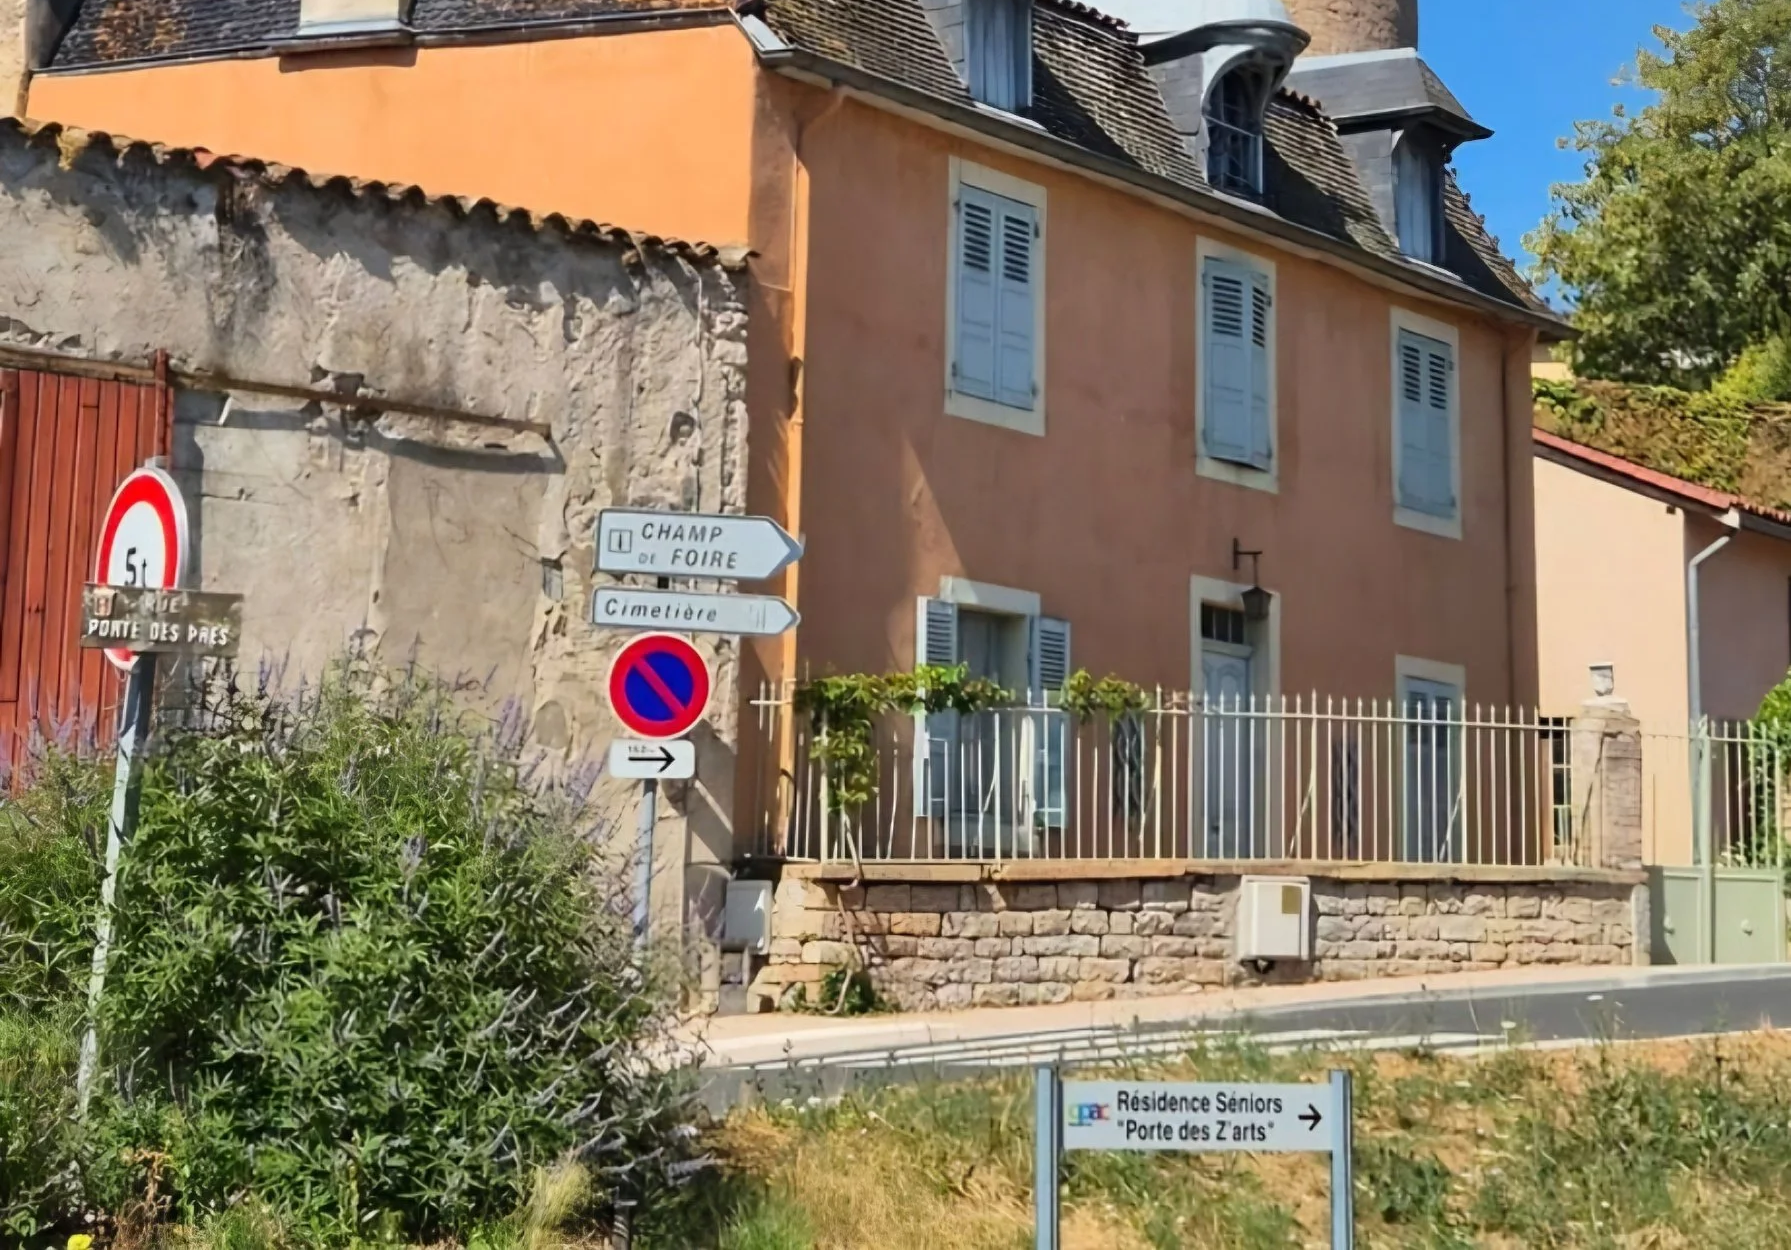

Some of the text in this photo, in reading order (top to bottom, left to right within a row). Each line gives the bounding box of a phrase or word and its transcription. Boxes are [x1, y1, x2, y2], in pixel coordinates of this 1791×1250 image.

[642, 523, 722, 543] CHAMP
[671, 549, 738, 569] FOIRE
[605, 598, 717, 622] Cimetière
[150, 622, 180, 642] DES
[1117, 1089, 1283, 1114] Résidence Séniors
[1117, 1120, 1173, 1141] "Porte
[1179, 1121, 1210, 1142] des
